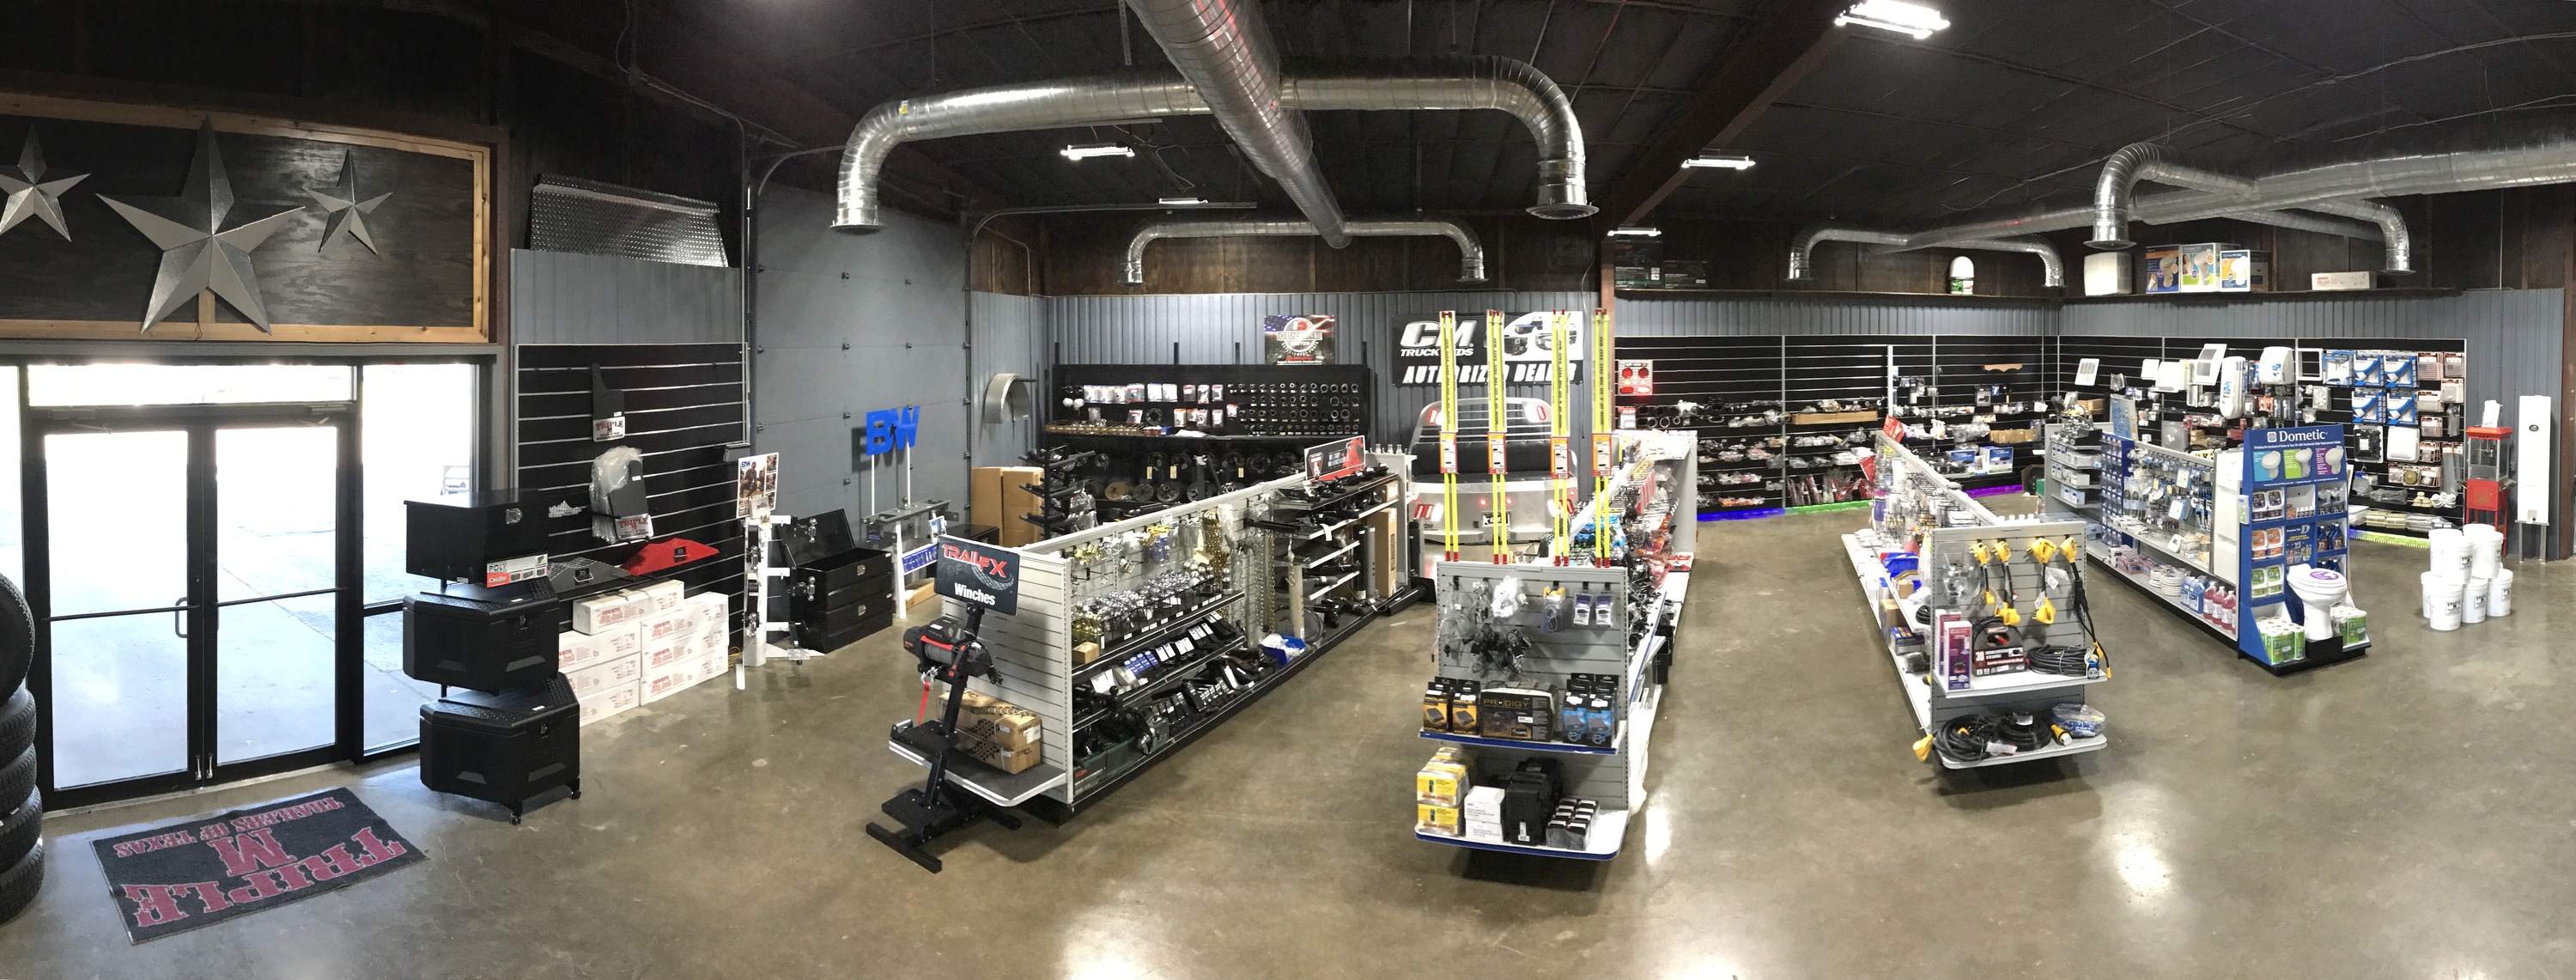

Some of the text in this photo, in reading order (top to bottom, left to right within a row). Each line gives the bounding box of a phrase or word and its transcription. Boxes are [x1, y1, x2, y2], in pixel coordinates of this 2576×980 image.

[2279, 429, 2326, 442] Dometic
[618, 517, 648, 528] TRIPLE
[489, 563, 507, 572] POLY
[942, 544, 1007, 578] TRAILFX
[954, 582, 995, 606] Winches
[1976, 651, 1984, 661] 30
[113, 797, 345, 858] TRAILERS OF TEXAS
[208, 827, 299, 877] M
[120, 826, 407, 928] TRIPLE
